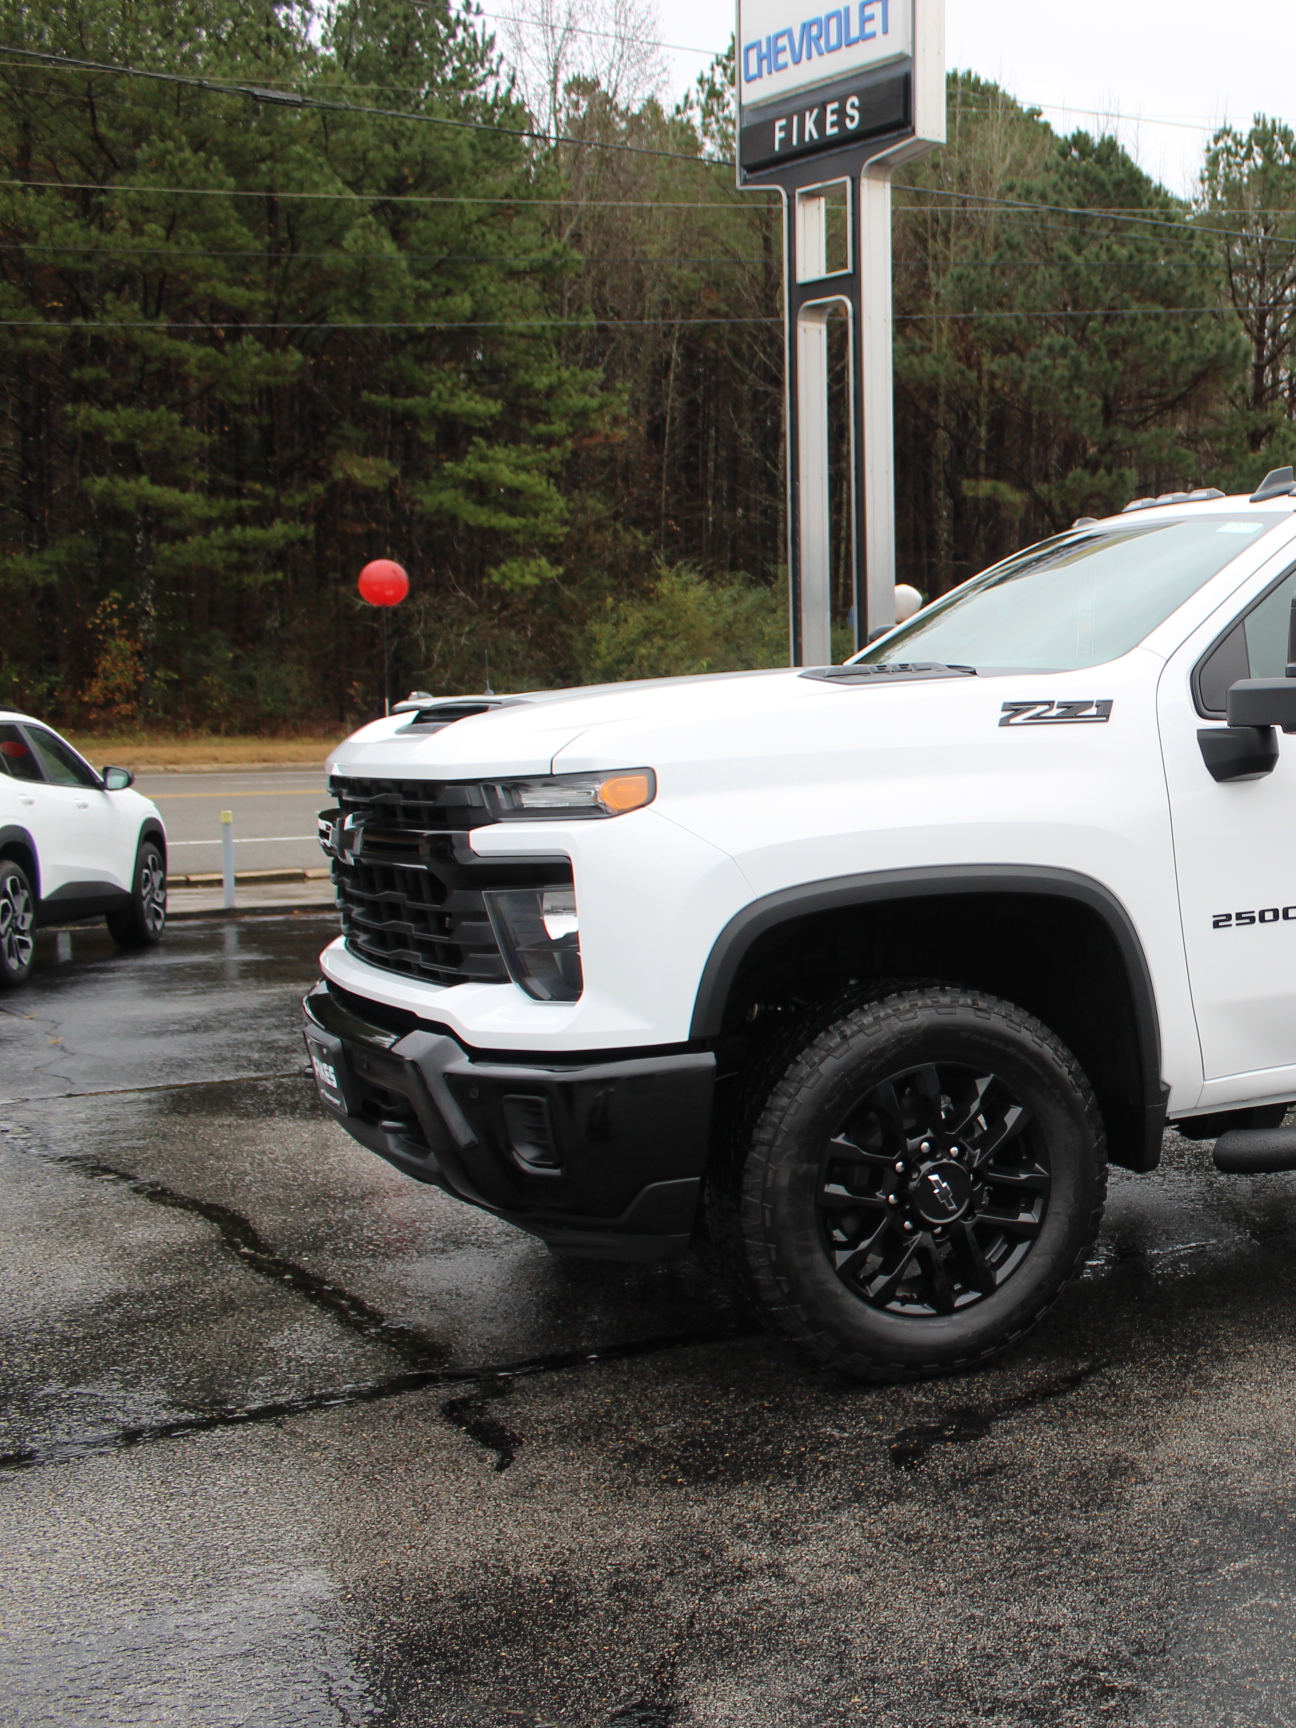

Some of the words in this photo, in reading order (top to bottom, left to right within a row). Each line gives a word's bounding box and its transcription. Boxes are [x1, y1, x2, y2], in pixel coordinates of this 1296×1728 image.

[743, 0, 889, 83] CHEVROLET
[774, 95, 860, 152] FIKES
[998, 699, 1114, 727] Z71
